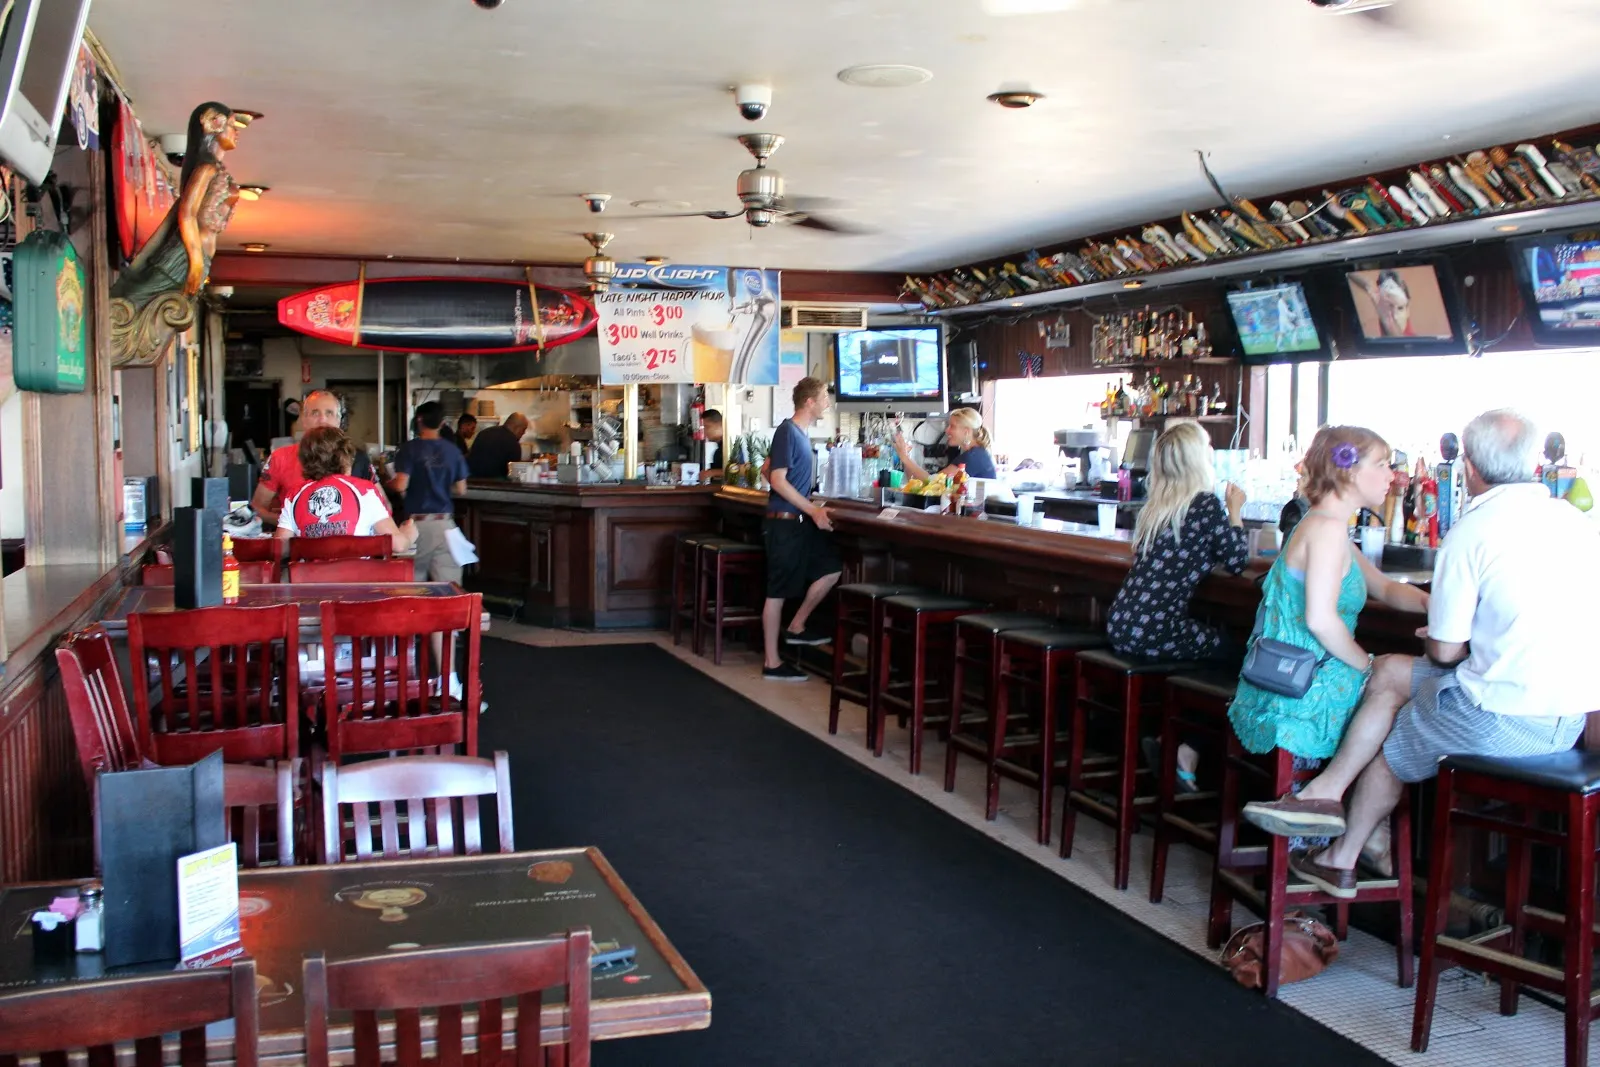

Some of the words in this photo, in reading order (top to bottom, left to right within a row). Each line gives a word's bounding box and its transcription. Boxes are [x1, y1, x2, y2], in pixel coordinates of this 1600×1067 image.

[611, 268, 648, 279] UD
[658, 269, 719, 280] LIGHT
[600, 293, 623, 303] LATE
[626, 291, 658, 303] NIGHT
[661, 290, 699, 302] HAPPY
[700, 290, 725, 302] HOUR
[613, 307, 624, 317] All
[626, 307, 645, 317] Pints
[641, 330, 657, 339] Well
[659, 330, 684, 339] Drinks
[612, 353, 637, 362] Taco's
